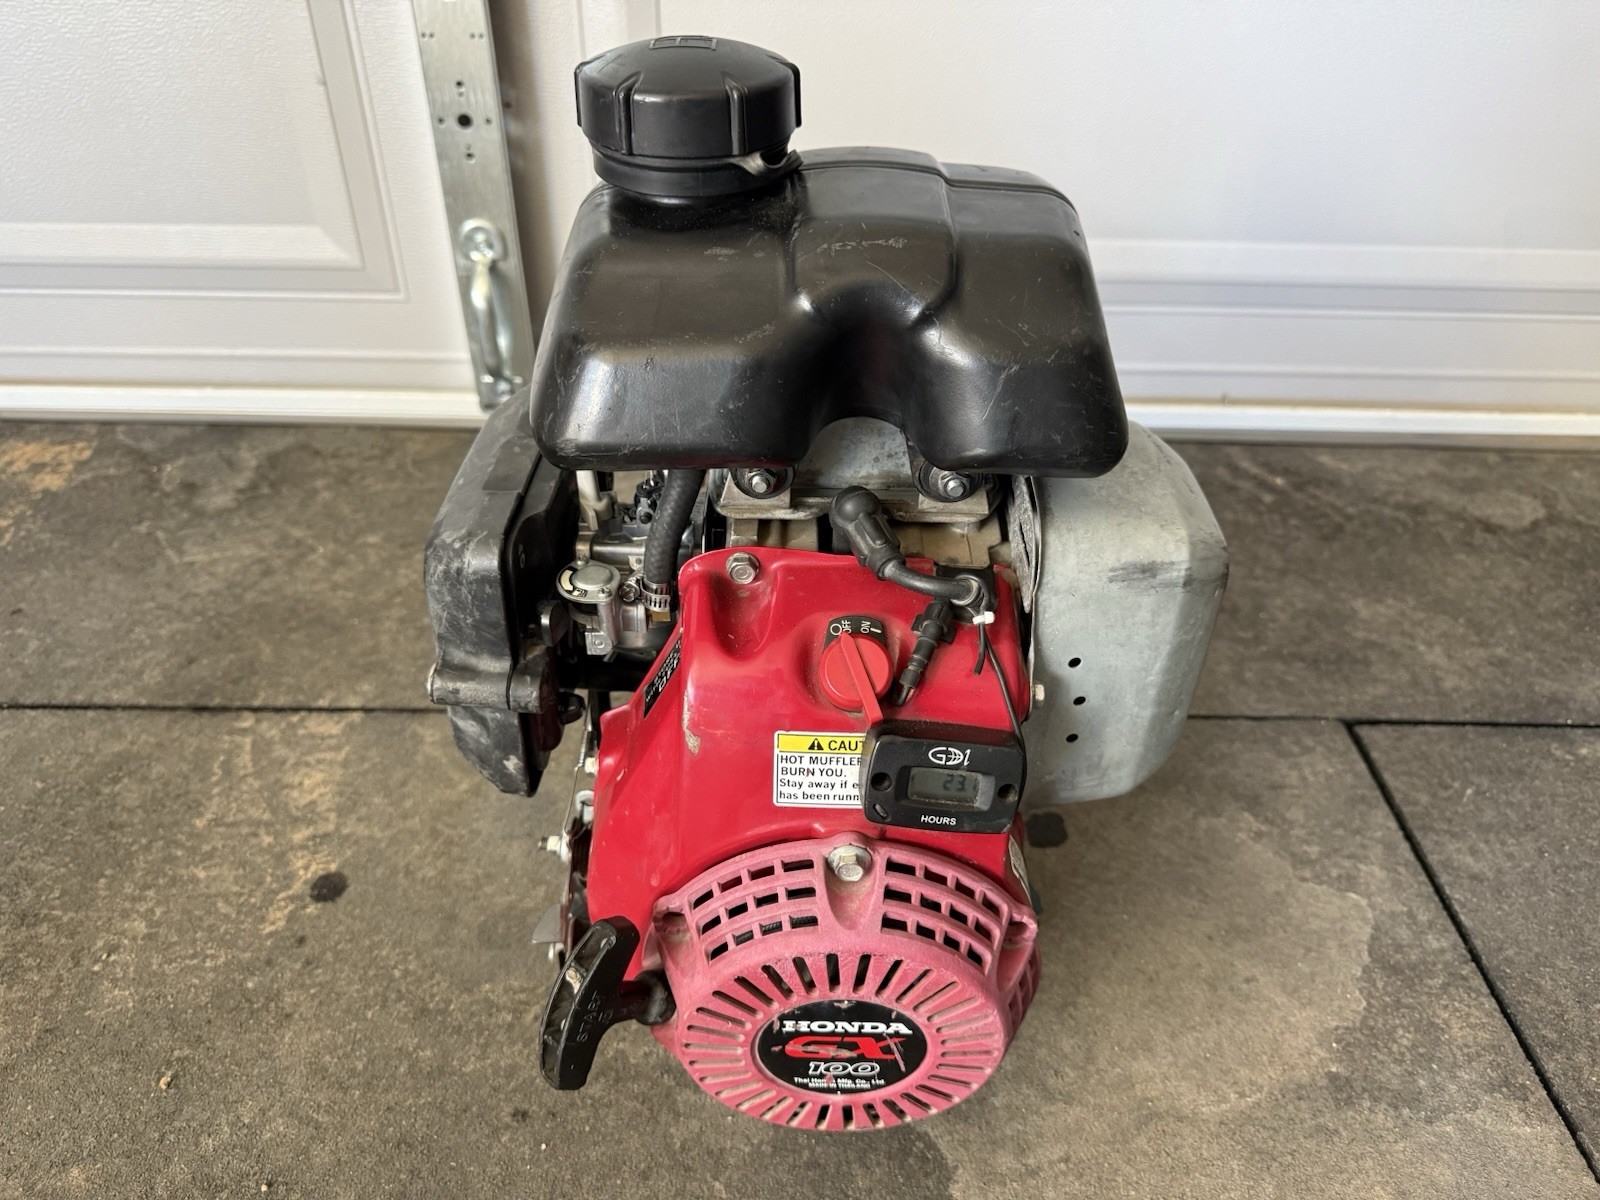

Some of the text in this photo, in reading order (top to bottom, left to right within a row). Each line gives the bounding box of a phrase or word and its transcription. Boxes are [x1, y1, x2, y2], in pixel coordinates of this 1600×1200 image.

[860, 620, 871, 634] ON
[780, 755, 804, 764] HOT
[781, 766, 847, 777] BURN YOU.
[780, 778, 803, 789] Stay
[808, 781, 836, 790] away
[840, 780, 848, 788] if
[780, 790, 798, 799] has
[802, 791, 830, 800] been
[920, 814, 957, 826] HOURS
[782, 1020, 913, 1034] HONDA
[784, 1035, 906, 1060] GX
[808, 1061, 880, 1076] 100
